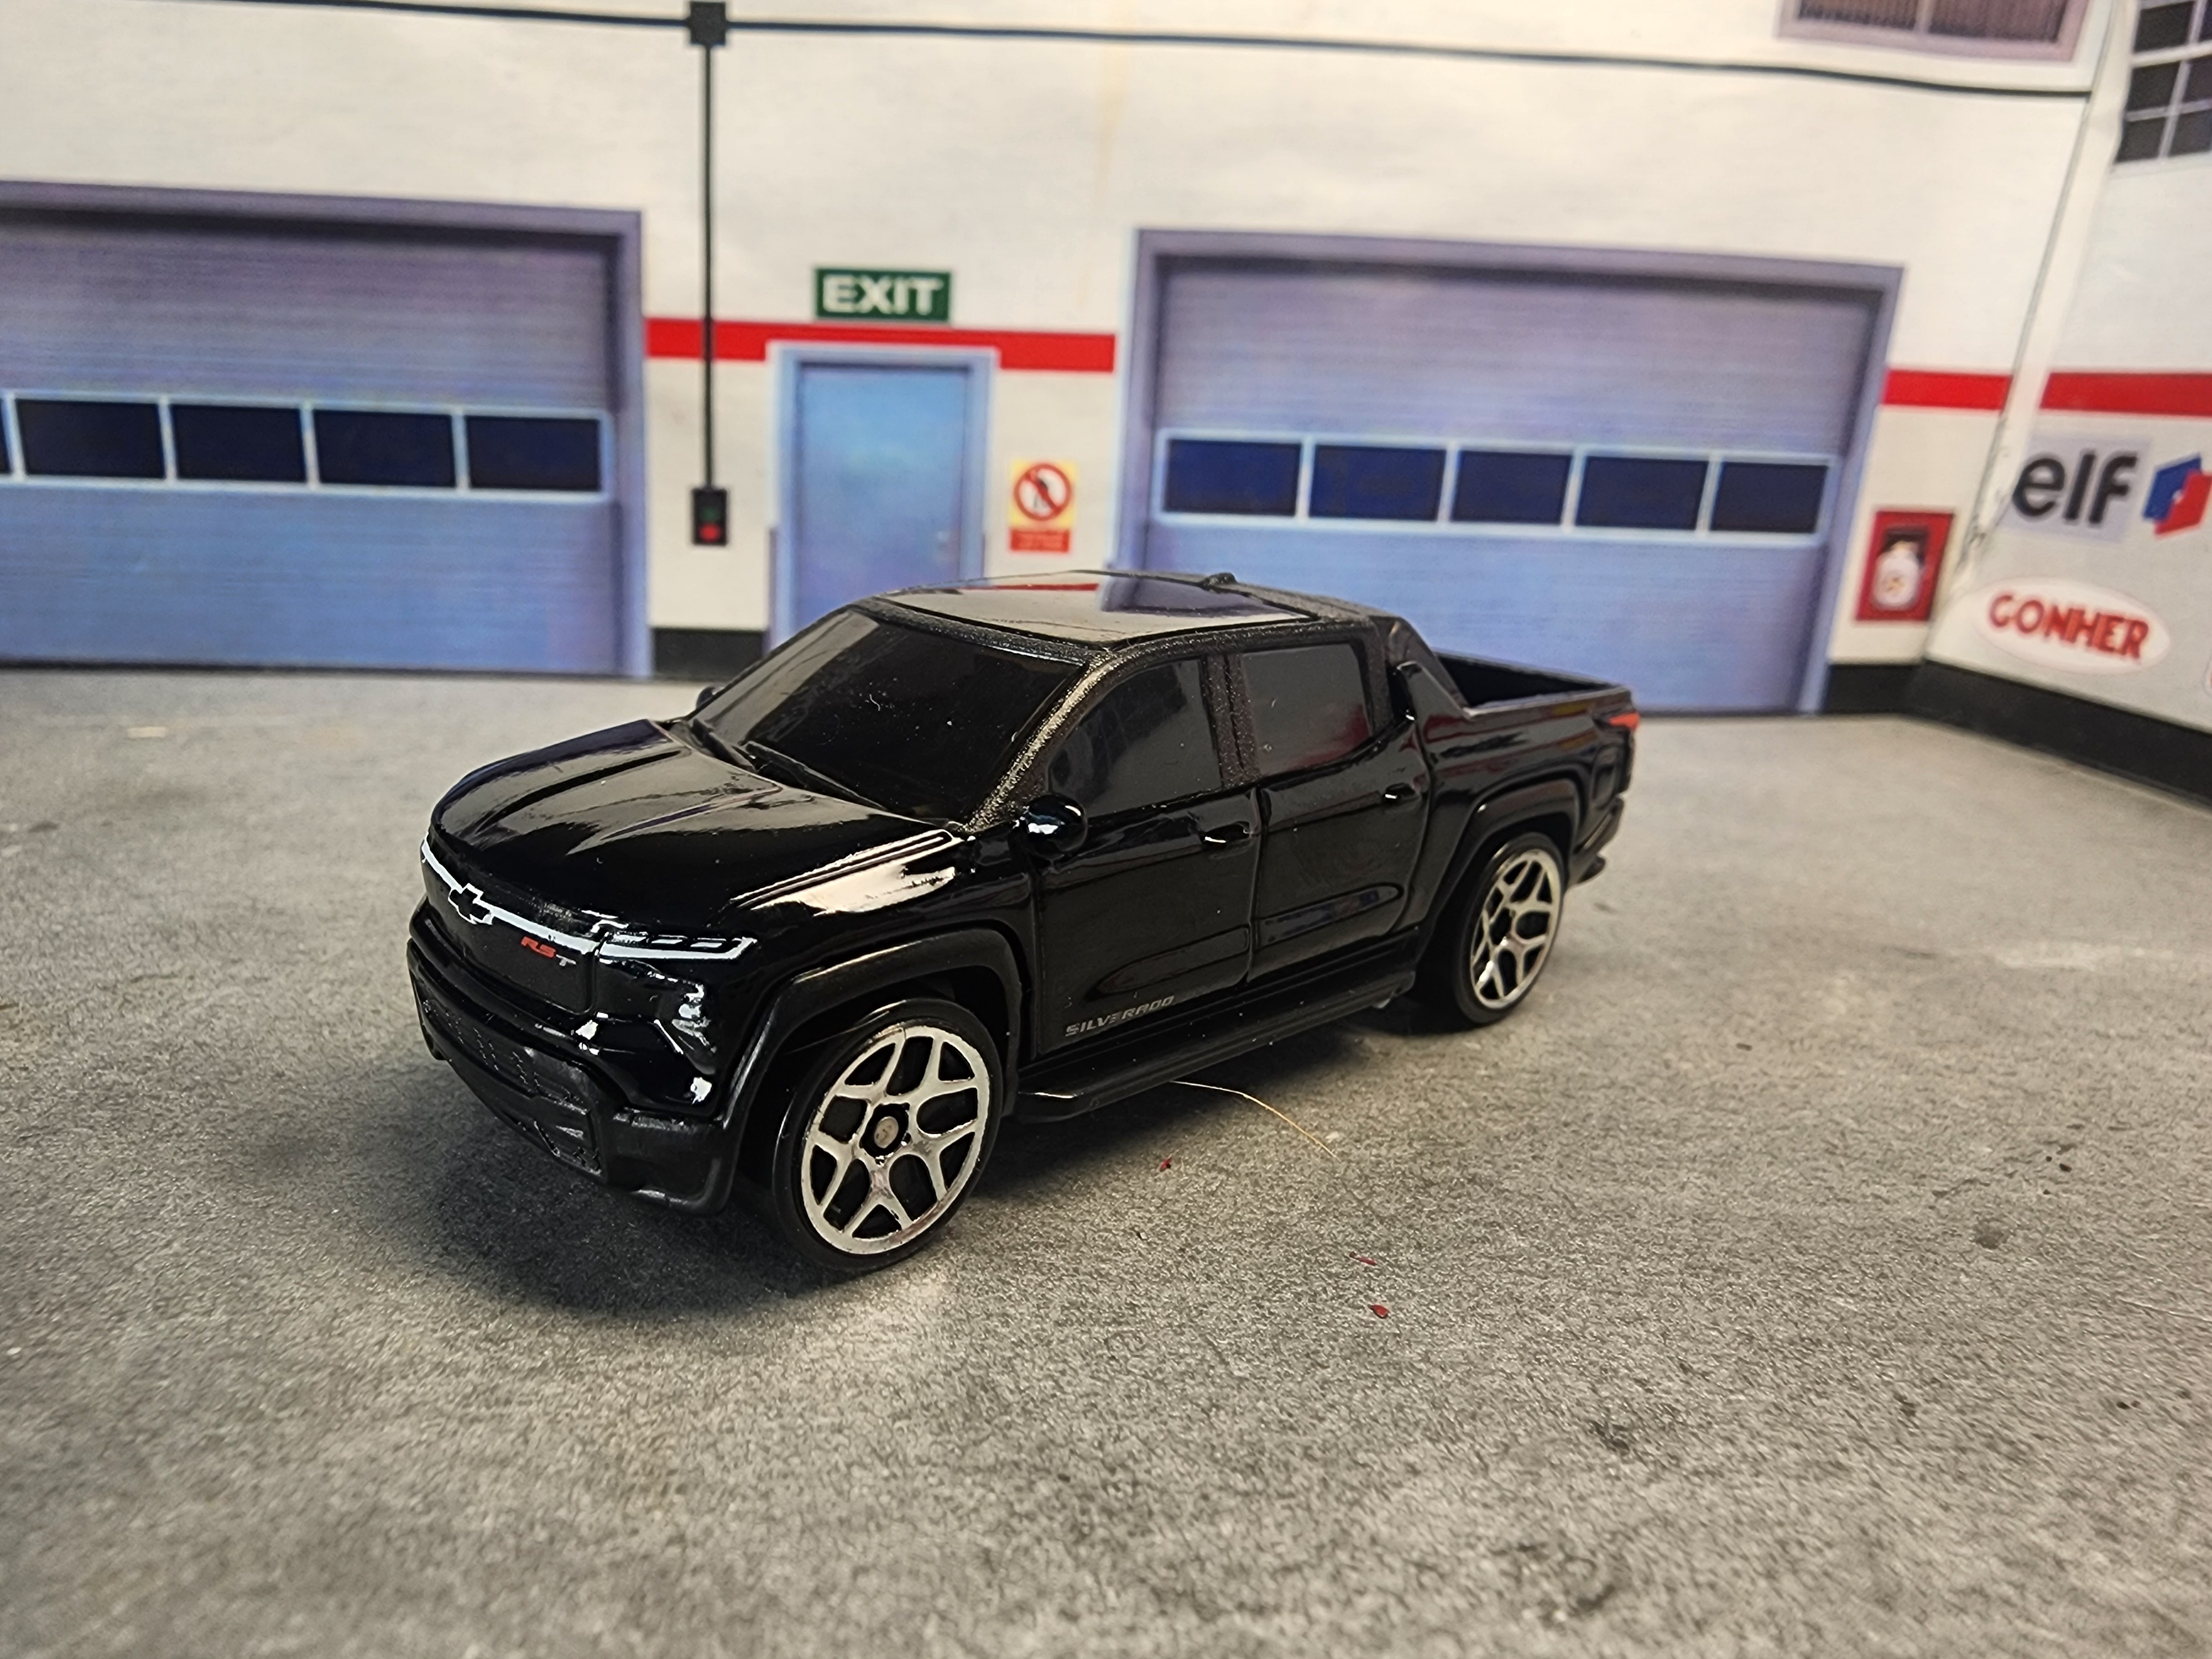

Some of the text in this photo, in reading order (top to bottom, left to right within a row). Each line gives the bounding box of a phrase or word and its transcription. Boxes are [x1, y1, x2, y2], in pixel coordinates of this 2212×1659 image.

[822, 274, 945, 316] EXIT
[2012, 452, 2138, 524] elf
[1065, 995, 1175, 1037] SILVERADO
